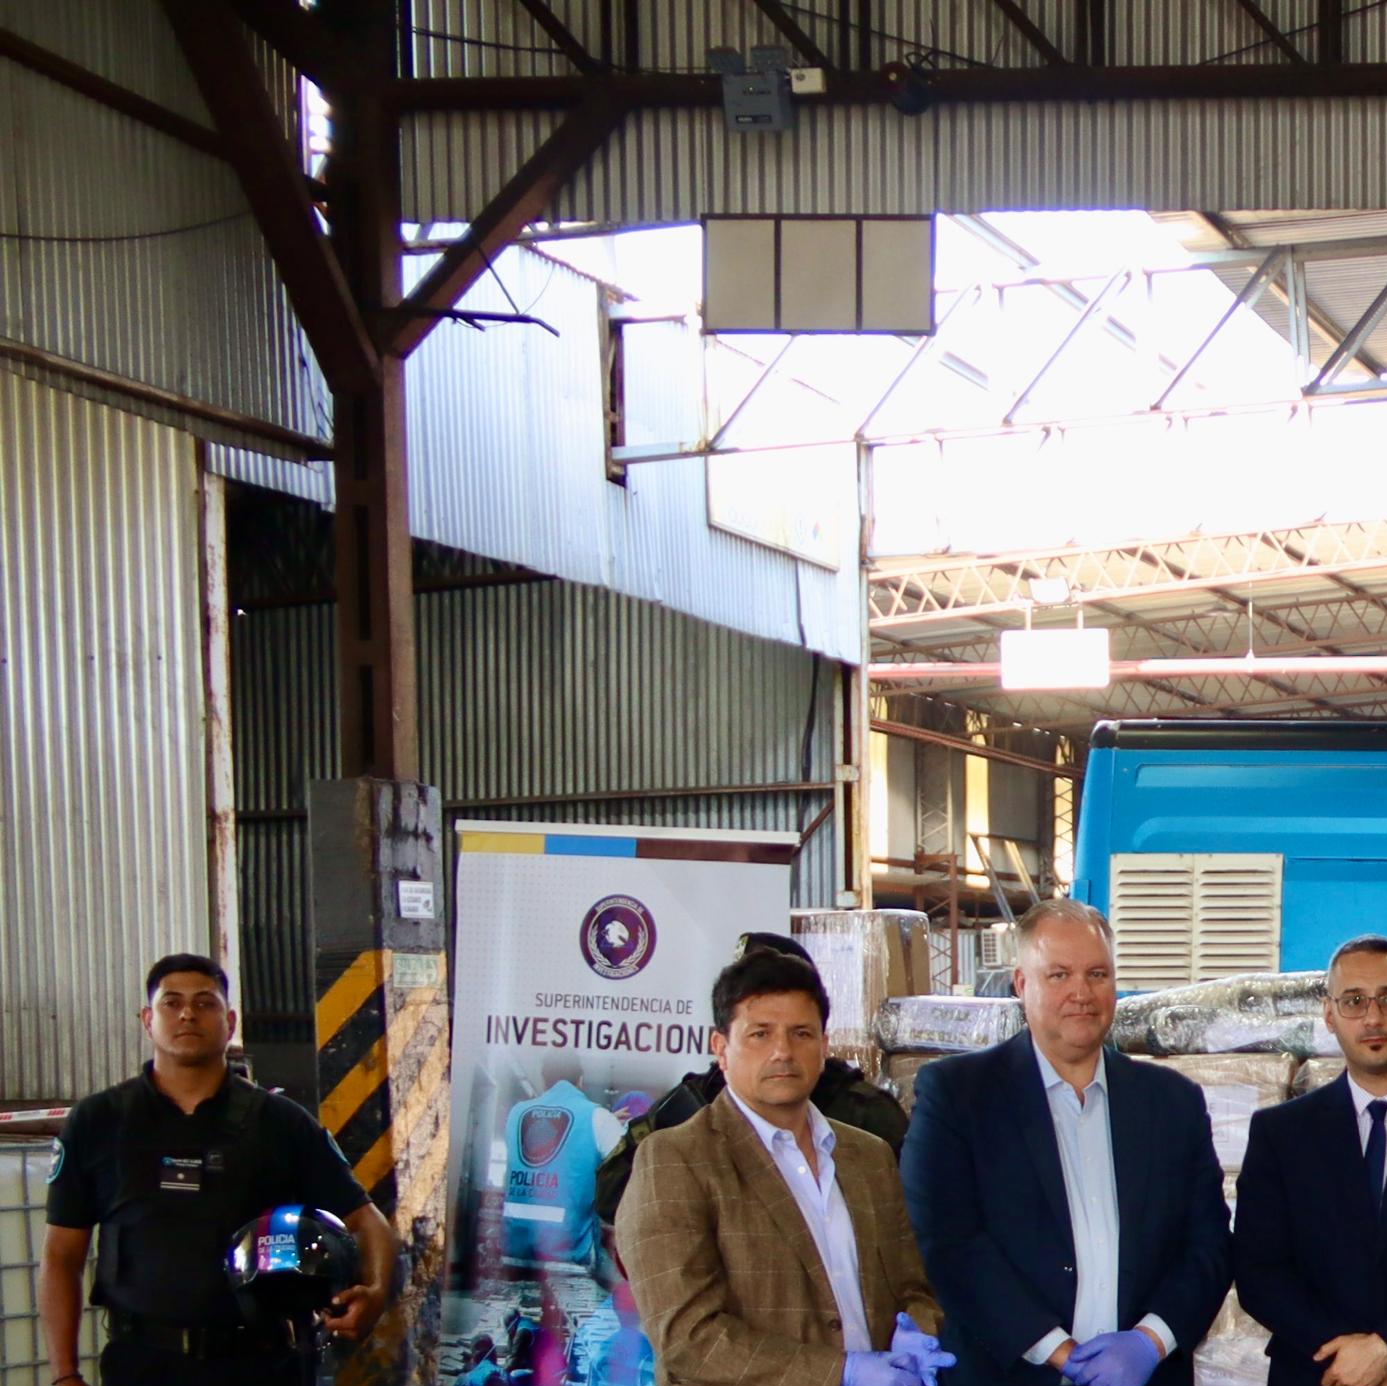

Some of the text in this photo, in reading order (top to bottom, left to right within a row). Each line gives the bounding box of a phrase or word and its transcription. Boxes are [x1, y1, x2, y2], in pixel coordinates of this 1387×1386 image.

[535, 992, 694, 1015] SUPERINTENDENCIA DE
[510, 1171, 559, 1188] POLICIA
[258, 1233, 296, 1247] POLICIA
